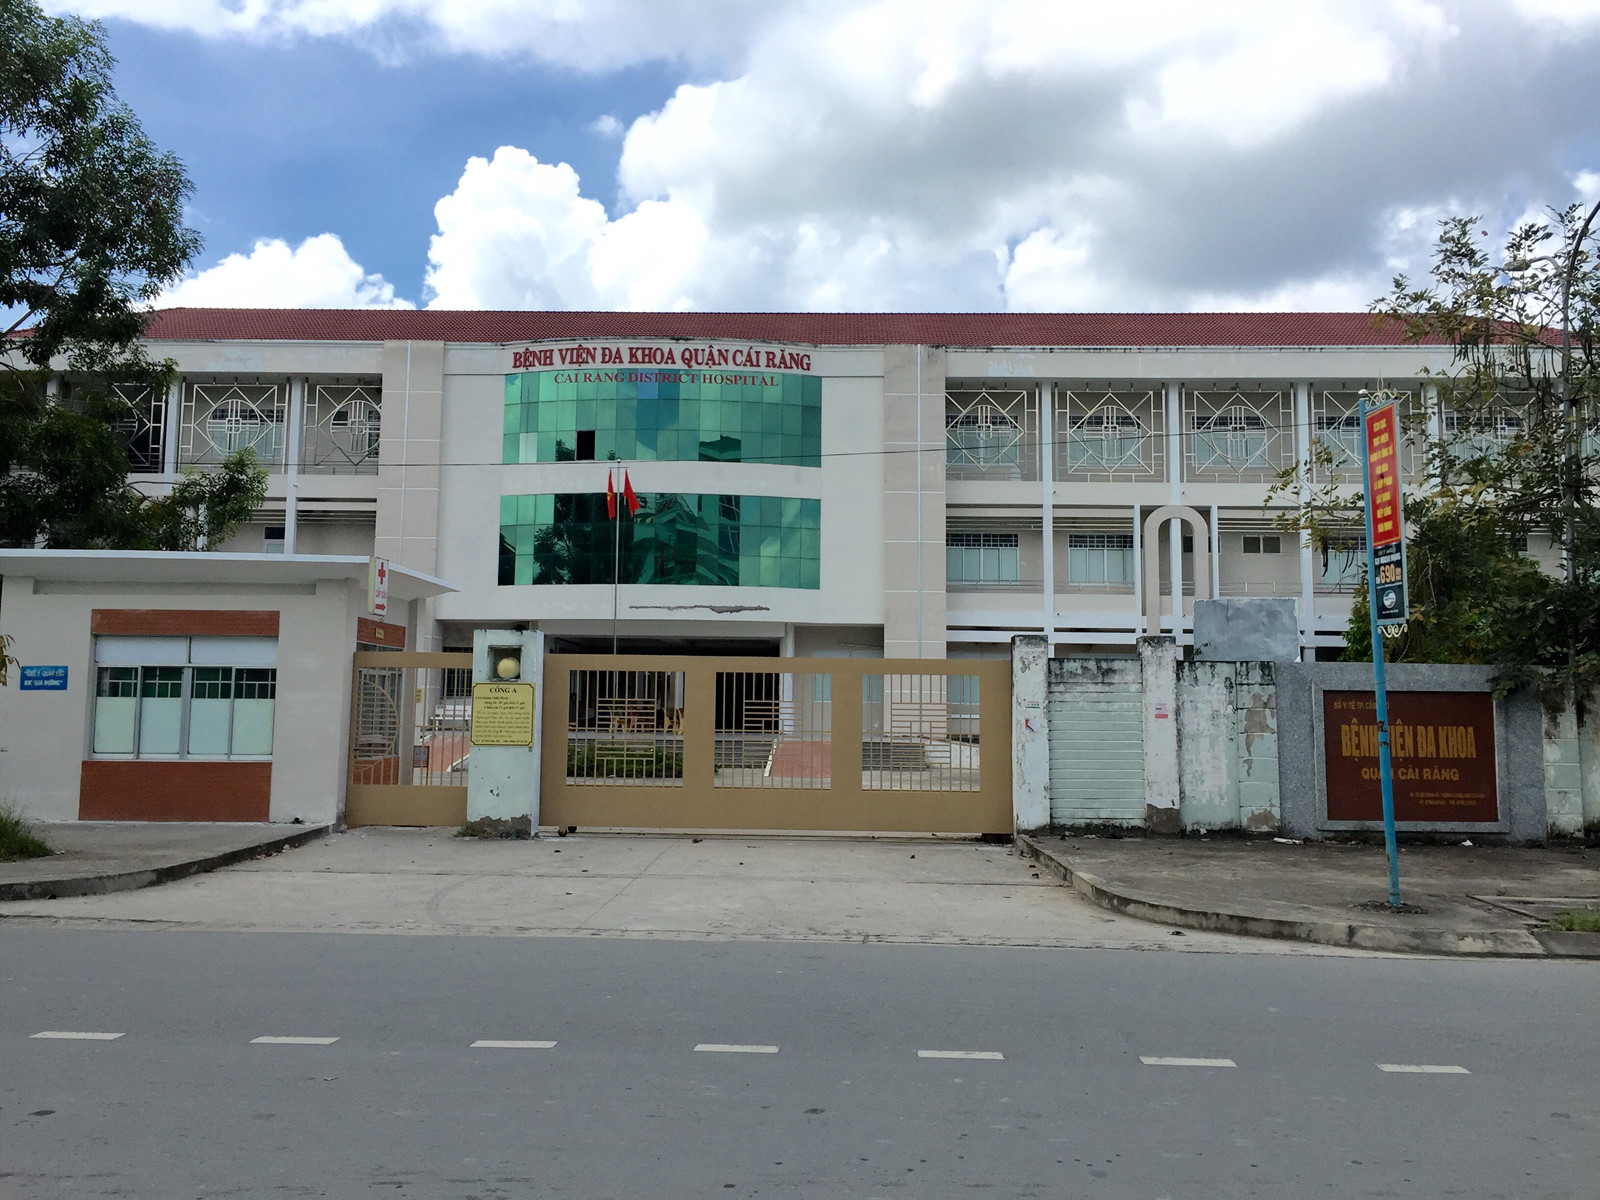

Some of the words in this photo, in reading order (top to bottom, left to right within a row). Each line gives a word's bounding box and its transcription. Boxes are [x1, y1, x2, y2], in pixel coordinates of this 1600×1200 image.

[512, 347, 554, 370] BỆNH
[558, 344, 597, 366] VIỆN
[601, 347, 623, 364] ĐA
[628, 347, 676, 365] KHOA
[681, 345, 729, 368] QUẬN
[732, 346, 761, 367] CÁI
[765, 348, 811, 371] RĂNG
[554, 372, 580, 384] CAI
[583, 372, 625, 383] RANG
[628, 372, 698, 384] DISTRICT
[702, 373, 779, 387] HOSPITAL
[1380, 563, 1395, 583] 690
[1341, 717, 1379, 761] BỆNH
[1387, 718, 1414, 762] IỆN
[1417, 725, 1436, 758] ĐA
[1438, 725, 1477, 759] KHOA
[1423, 766, 1460, 781] RĂNG
